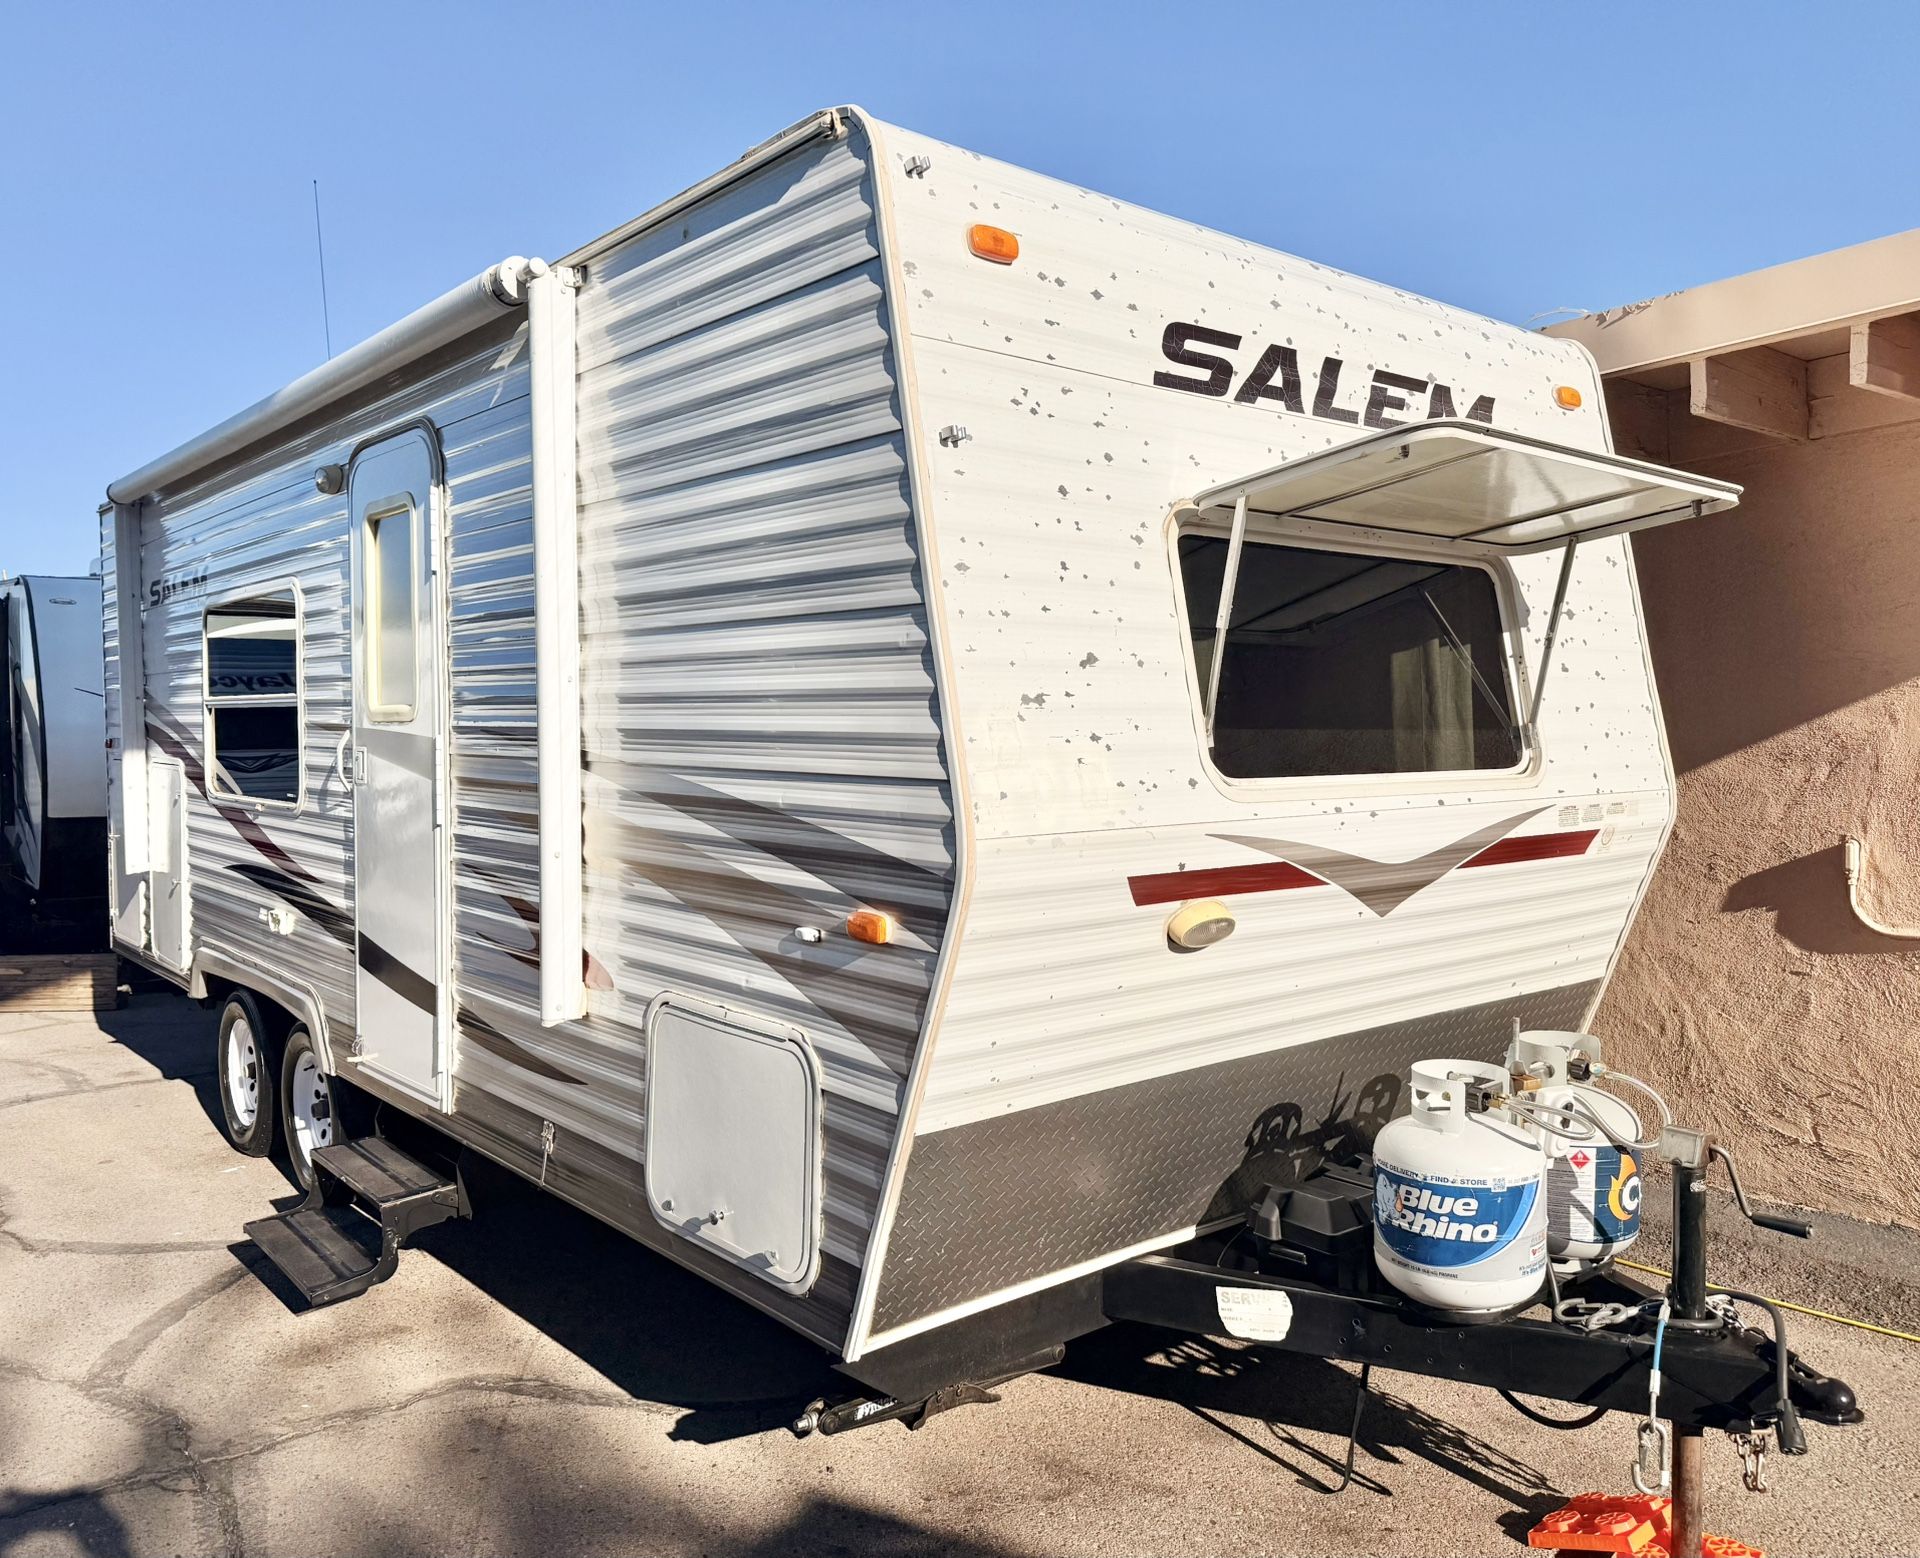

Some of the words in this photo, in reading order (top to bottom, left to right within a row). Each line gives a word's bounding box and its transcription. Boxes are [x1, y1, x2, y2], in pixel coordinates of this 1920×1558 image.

[1153, 320, 1496, 430] SALEM
[1389, 1163, 1419, 1178] DELIVERY
[1430, 1175, 1449, 1184] FIND
[1459, 1178, 1488, 1186] STORE
[1398, 1183, 1479, 1217] Blue
[1393, 1209, 1498, 1243] Rhino
